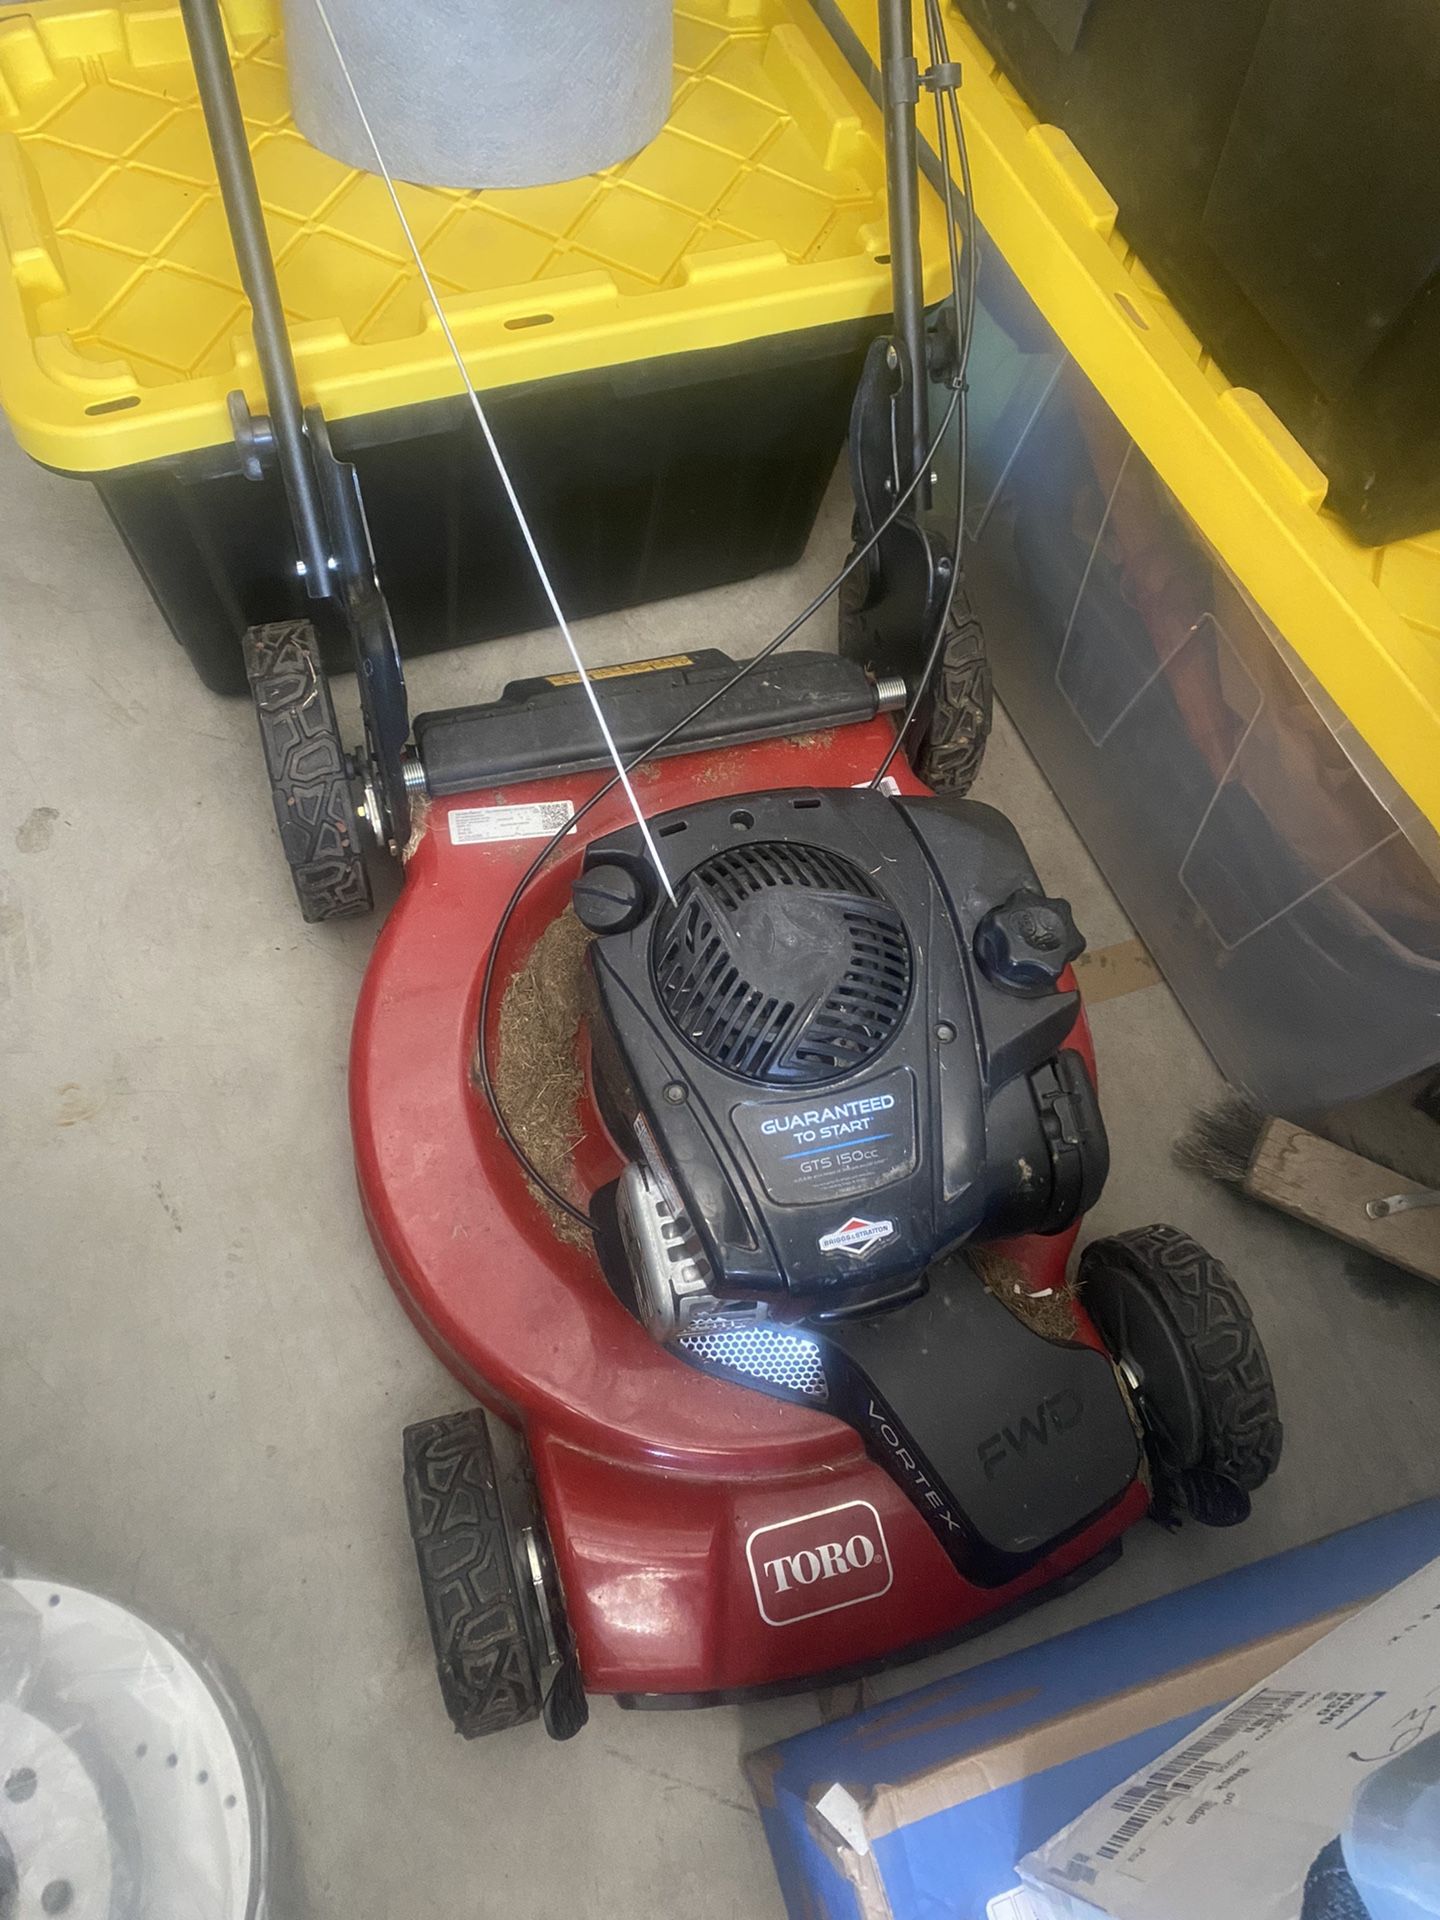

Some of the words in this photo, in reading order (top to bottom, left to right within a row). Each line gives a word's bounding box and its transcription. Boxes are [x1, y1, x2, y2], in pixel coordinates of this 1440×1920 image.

[761, 1094, 895, 1134] GUARANTEED
[793, 1130, 816, 1144] TO
[800, 1157, 833, 1173] GTS
[836, 1149, 879, 1166] 150cc
[977, 1389, 1083, 1481] FWD
[868, 1400, 961, 1531] VORTEX
[763, 1535, 875, 1593] TORO
